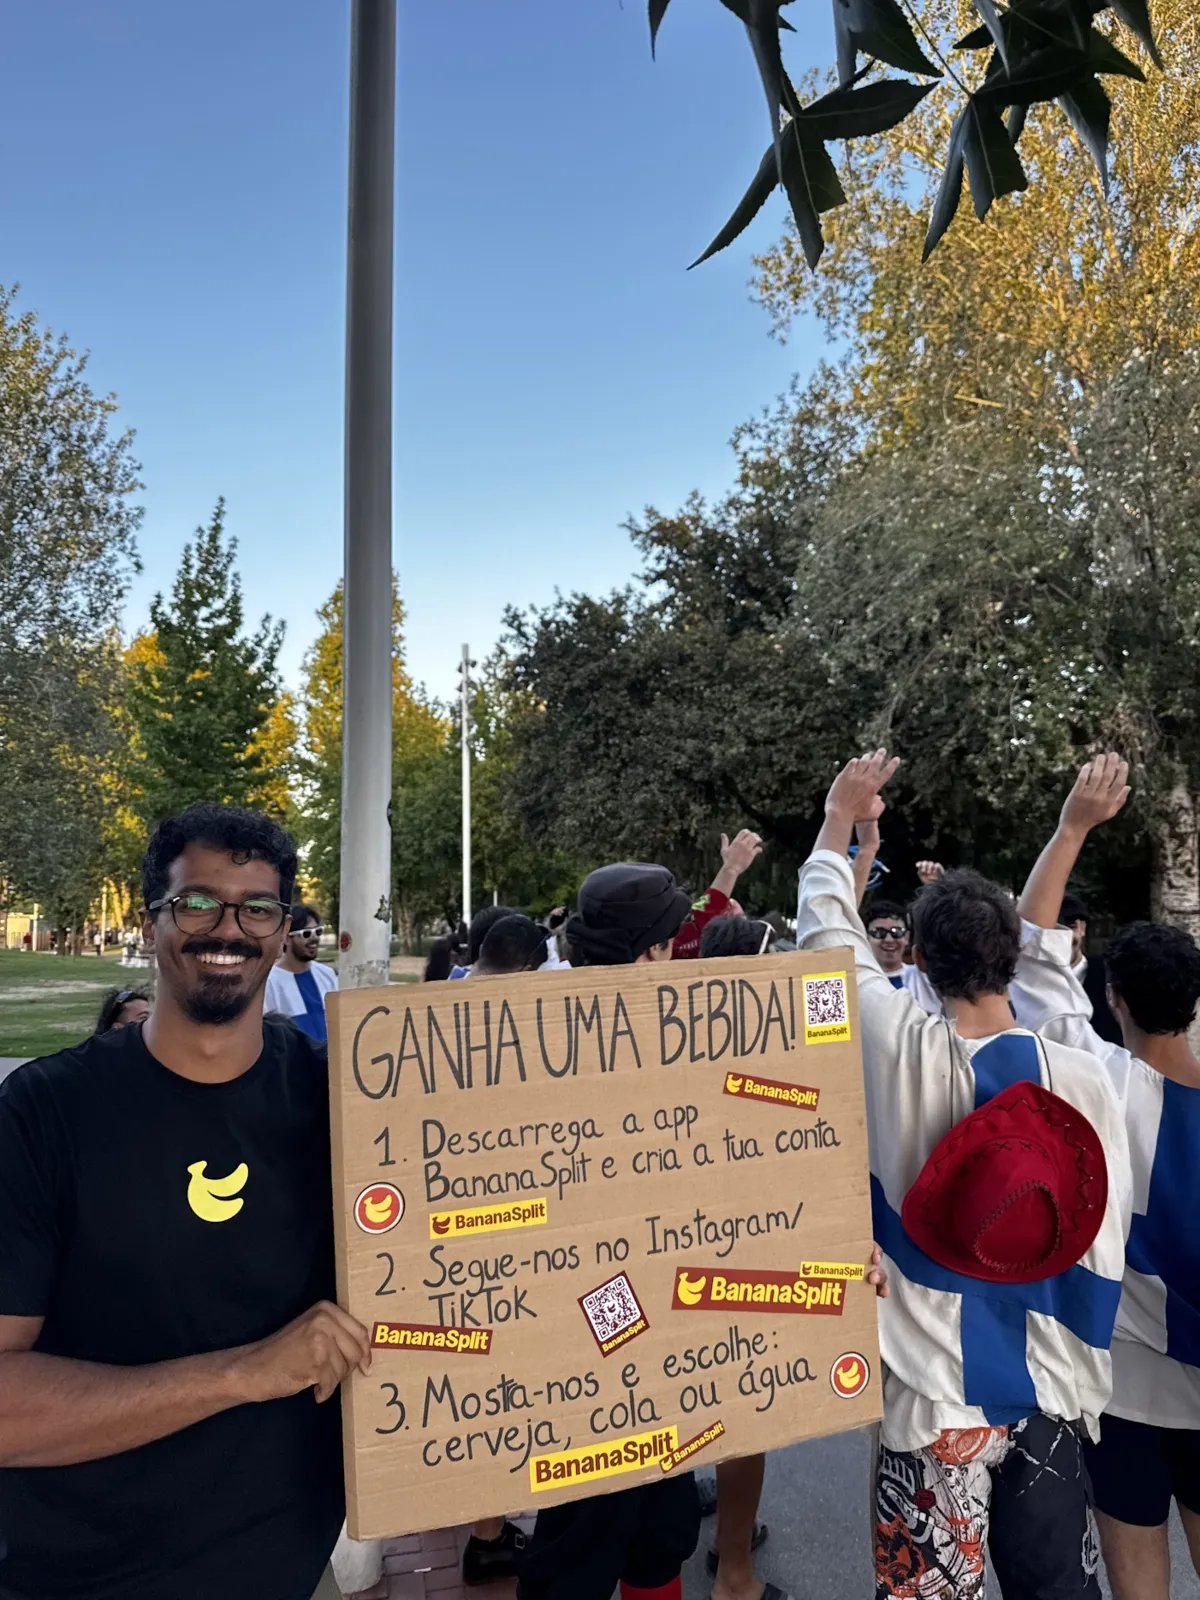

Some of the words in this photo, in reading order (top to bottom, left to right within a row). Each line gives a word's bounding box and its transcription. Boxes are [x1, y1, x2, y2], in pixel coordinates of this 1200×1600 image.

[353, 1000, 526, 1099] GANHA
[537, 992, 642, 1078] UMA
[658, 977, 795, 1065] BEBIDA!
[807, 1027, 847, 1038] BananaSplit
[743, 1079, 818, 1106] BananaSplit
[374, 1127, 407, 1166] 1.
[422, 1118, 604, 1159] Descarrega
[622, 1113, 644, 1134] a
[654, 1105, 698, 1140] app
[424, 1151, 592, 1202] BananaSplit
[601, 1156, 618, 1178] e
[632, 1148, 682, 1174] cria
[693, 1144, 714, 1165] a
[723, 1129, 764, 1162] tua
[775, 1118, 841, 1153] conta
[455, 1203, 546, 1230] BananaSplit
[375, 1252, 406, 1296] 2.
[423, 1245, 580, 1297] Segue-nos
[596, 1238, 629, 1263] no
[645, 1202, 803, 1258] Instagram/
[813, 1265, 863, 1277] BananaSplit
[710, 1277, 842, 1309] BananaSplit
[375, 1325, 489, 1353] BananaSplit
[602, 1319, 646, 1352] BananaSplit
[375, 1383, 410, 1434] 3.
[422, 1371, 599, 1428] Mostra-nos
[621, 1363, 640, 1388] e
[663, 1325, 779, 1377] escolhe:
[422, 1418, 572, 1473] cerveja,
[590, 1390, 662, 1434] cola
[680, 1381, 722, 1413] ou
[738, 1358, 818, 1412] água
[535, 1432, 673, 1483] BananaSplit
[674, 1423, 725, 1462] BananaSplit
